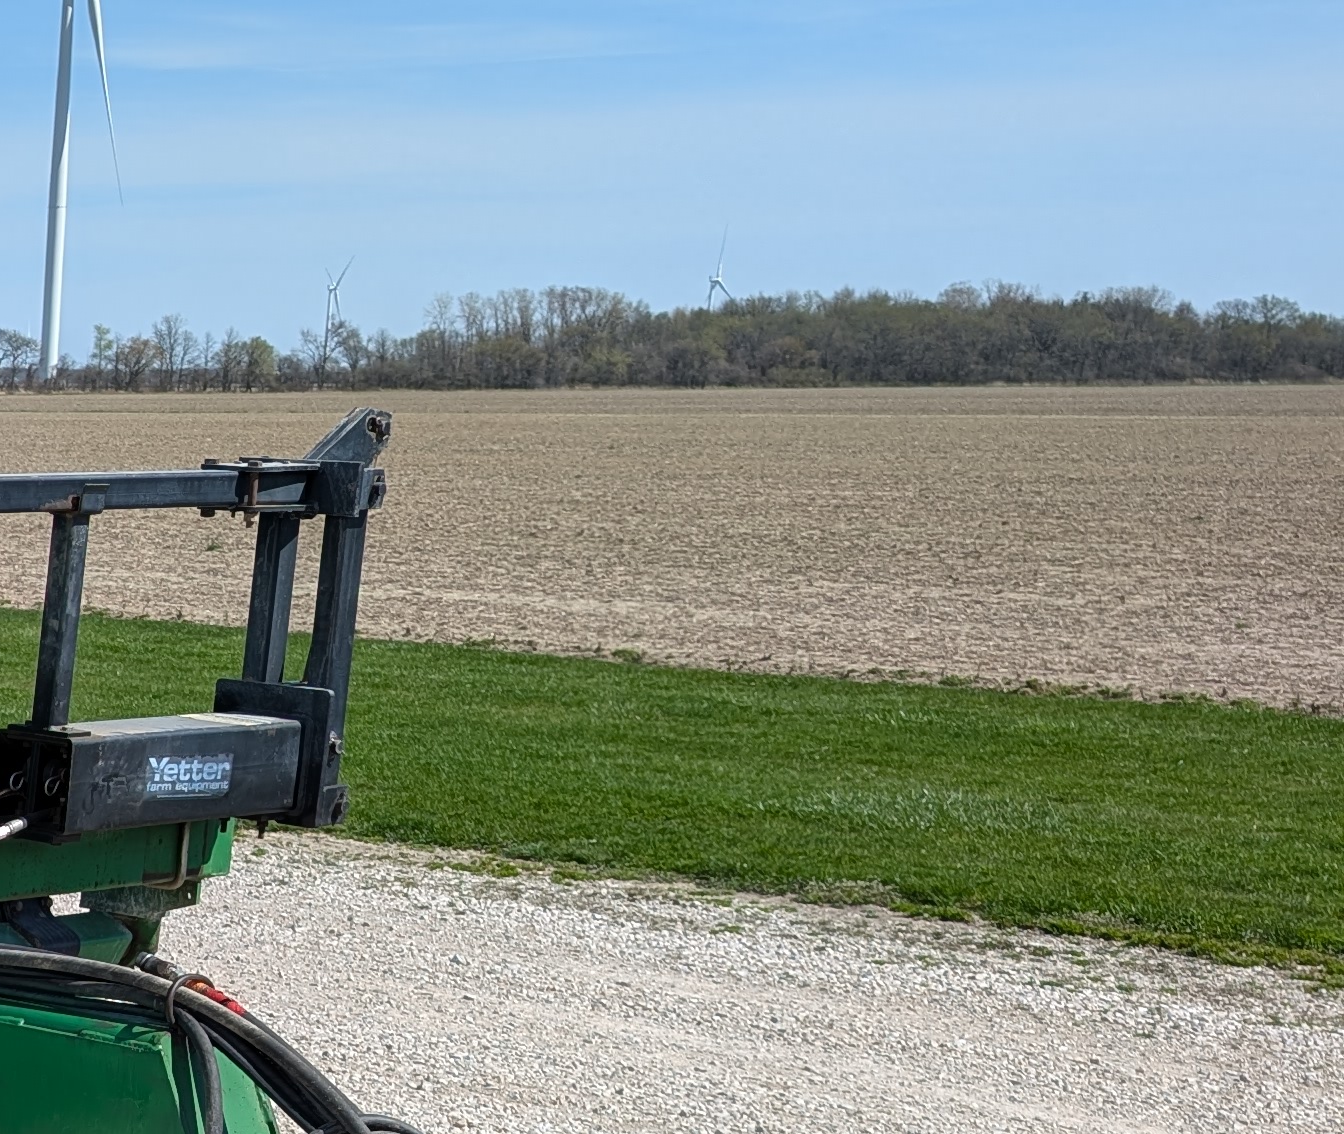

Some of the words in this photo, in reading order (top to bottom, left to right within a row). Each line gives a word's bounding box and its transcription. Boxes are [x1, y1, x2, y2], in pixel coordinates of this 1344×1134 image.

[149, 757, 230, 782] Yetter
[146, 781, 172, 792] farm
[175, 780, 229, 793] equipment
